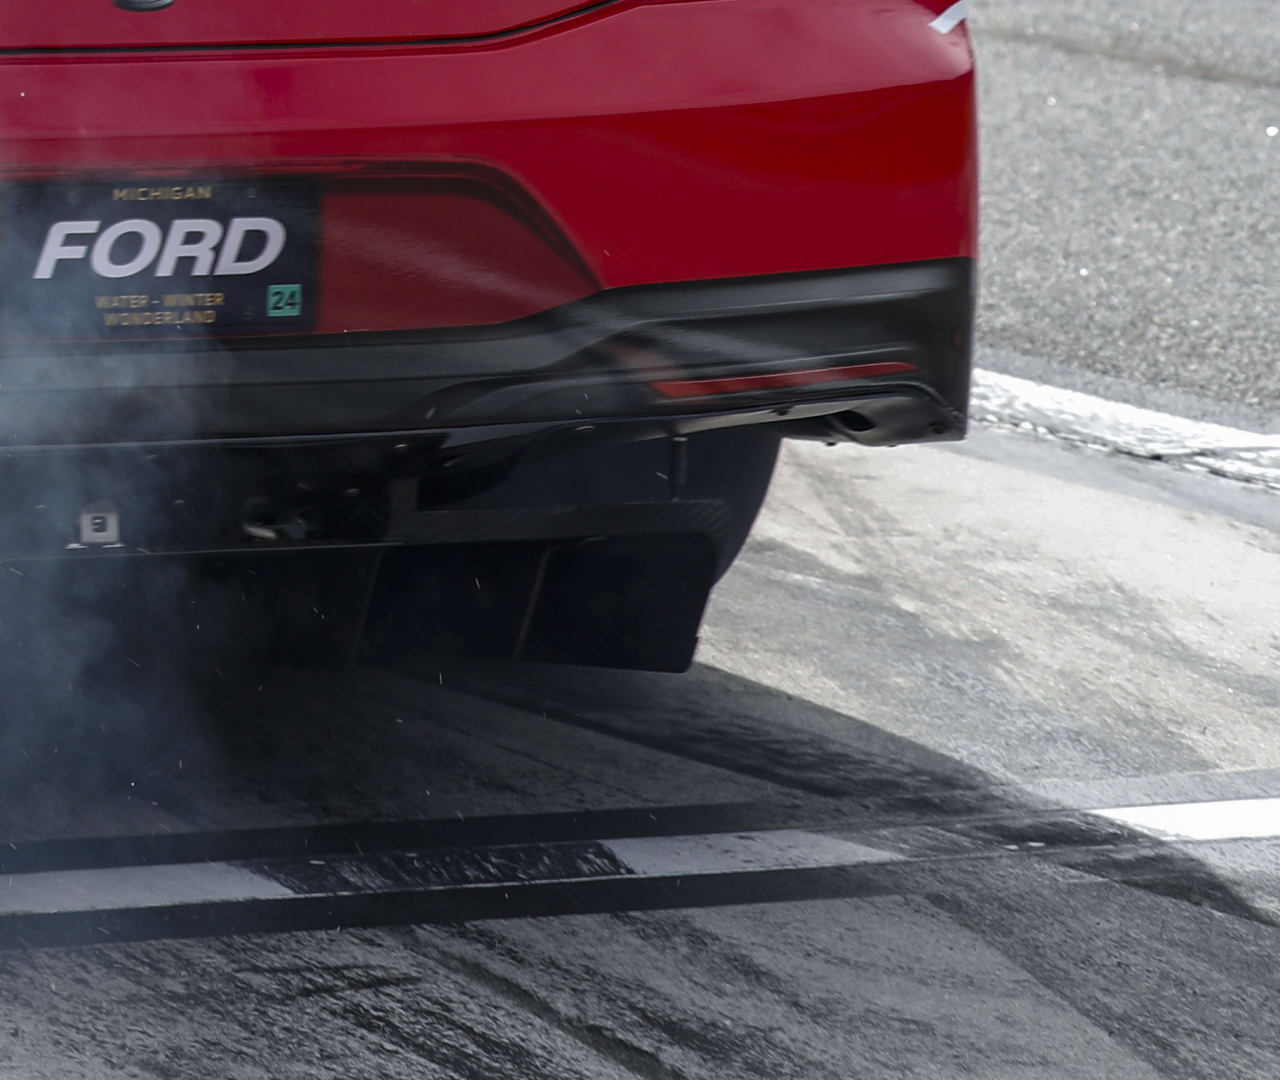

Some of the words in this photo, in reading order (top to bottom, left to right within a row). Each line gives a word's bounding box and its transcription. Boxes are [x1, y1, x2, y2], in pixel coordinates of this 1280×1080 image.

[112, 186, 213, 201] MICHIGAN
[32, 217, 287, 279] FORD
[95, 294, 149, 309] WATER
[162, 292, 225, 307] WINTER
[271, 290, 297, 310] 24
[103, 310, 217, 327] WONDERLAND
